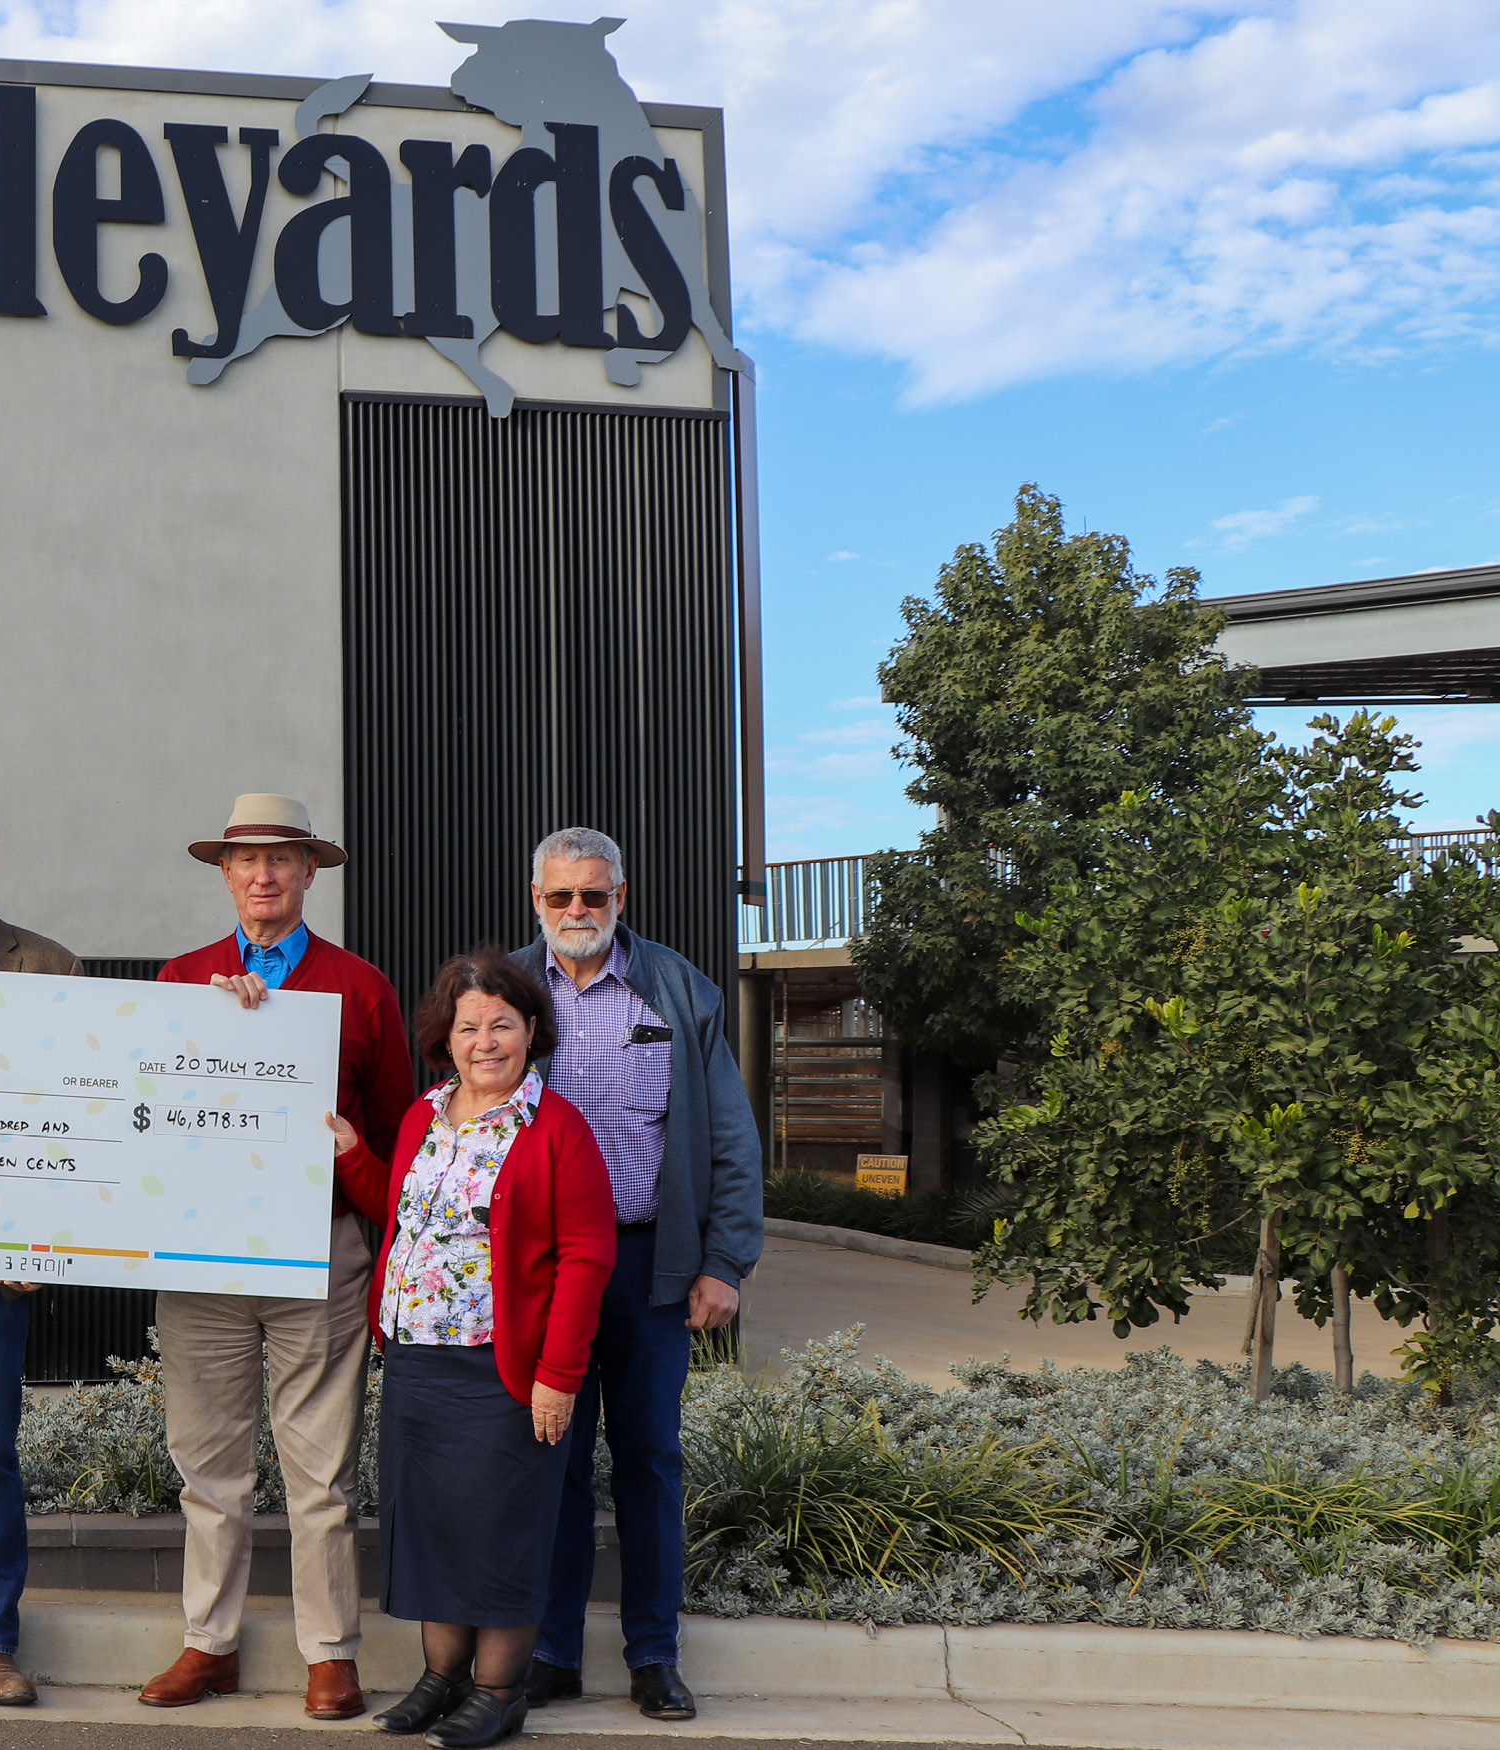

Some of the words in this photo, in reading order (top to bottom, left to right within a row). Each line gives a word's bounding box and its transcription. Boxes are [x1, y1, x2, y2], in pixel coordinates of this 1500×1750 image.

[139, 1062, 167, 1073] DATE
[175, 1055, 201, 1071] 20
[206, 1058, 247, 1076] JULY
[254, 1061, 299, 1080] 2022
[62, 1077, 77, 1086] OR
[79, 1078, 119, 1089] BEARER
[167, 1109, 261, 1130] 46,878.37
[41, 1121, 70, 1134] AND
[26, 1157, 77, 1172] CENTS
[860, 1157, 905, 1169] CAUTION
[862, 1174, 900, 1184] UNEVEN
